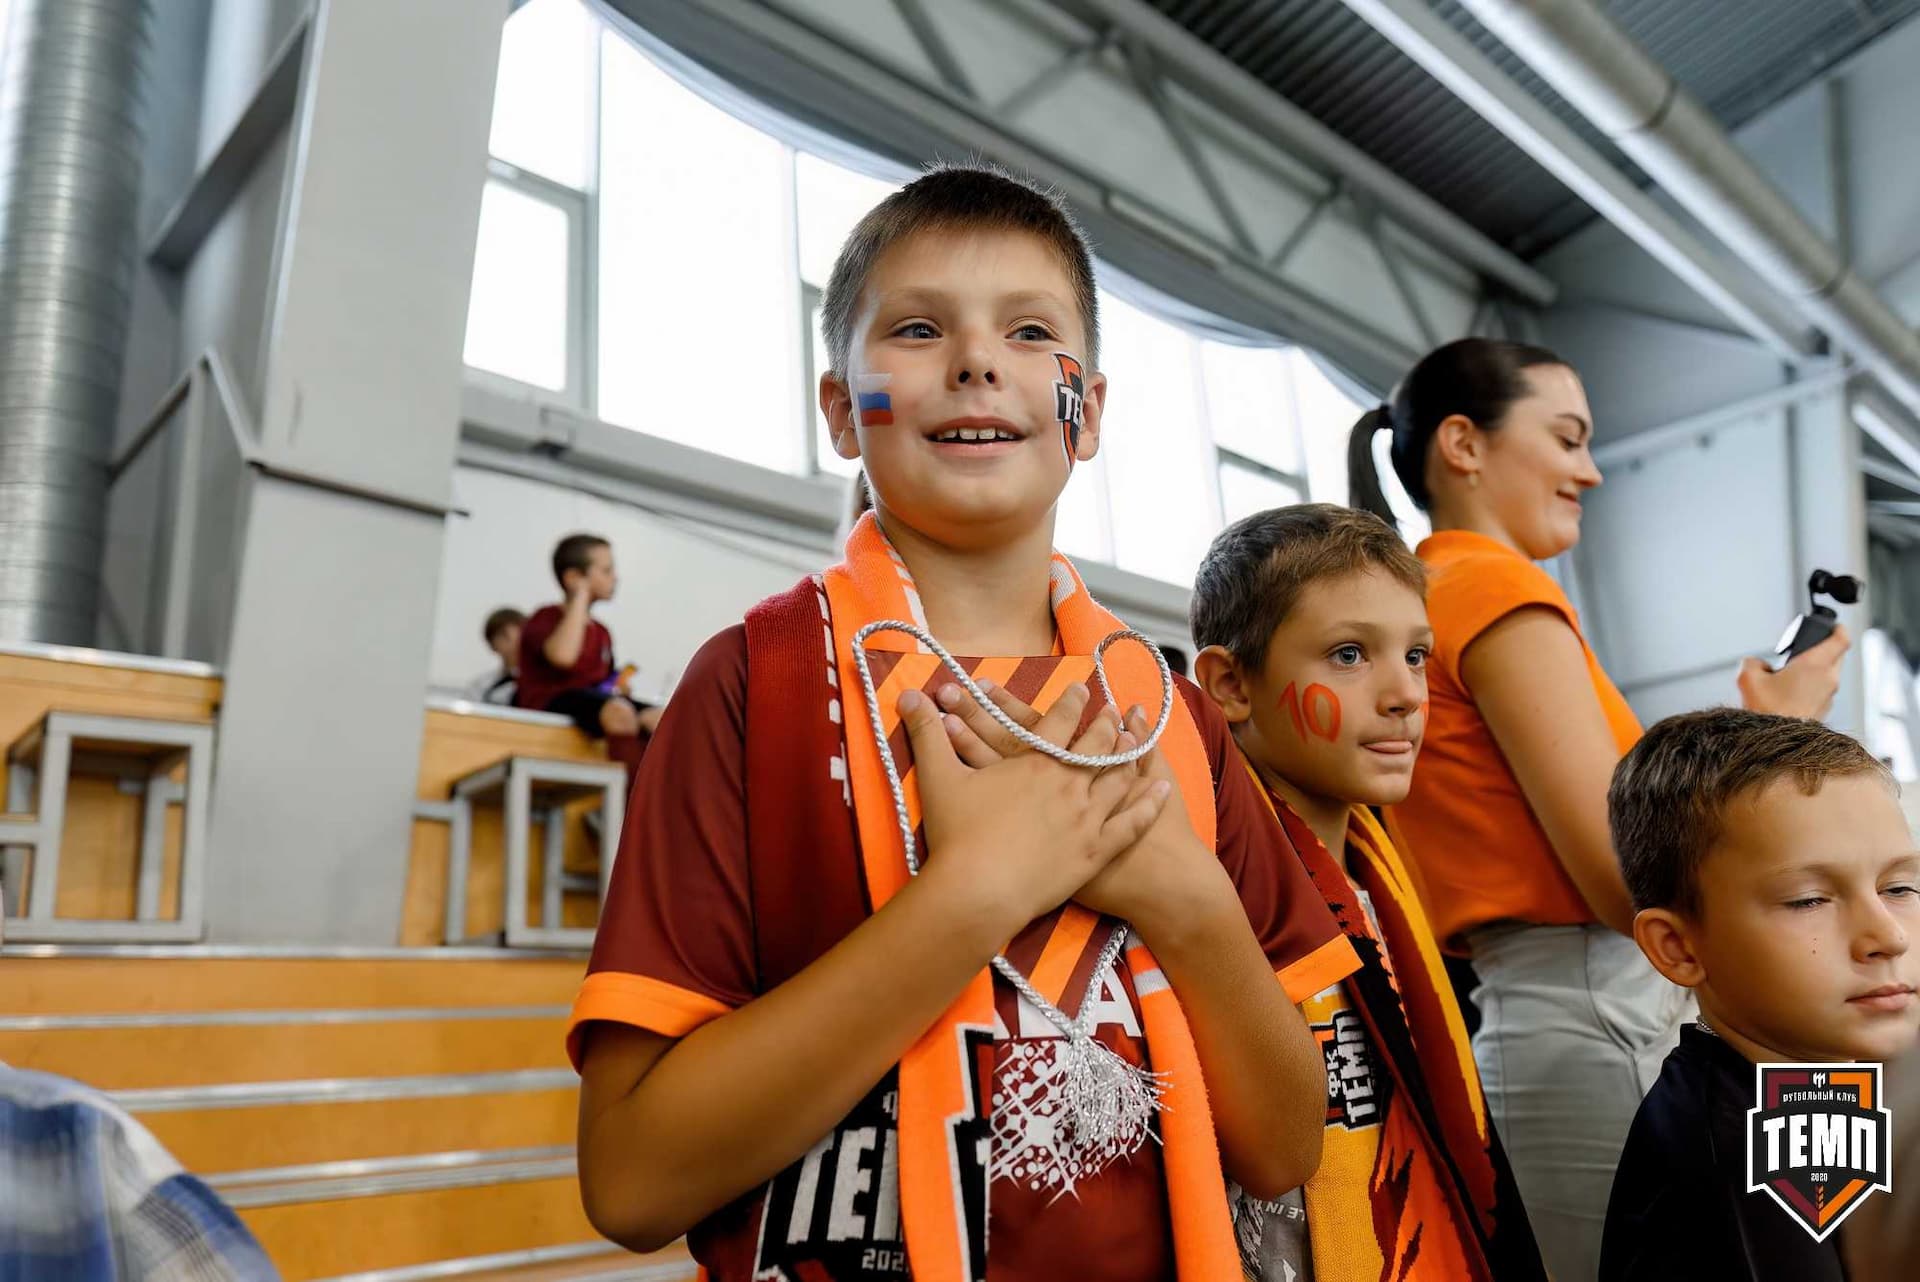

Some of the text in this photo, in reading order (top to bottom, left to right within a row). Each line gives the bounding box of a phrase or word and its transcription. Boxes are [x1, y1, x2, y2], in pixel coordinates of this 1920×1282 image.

[1275, 680, 1341, 744] 10
[1336, 1015, 1377, 1124] ТЕМП
[861, 1248, 909, 1272] 202
